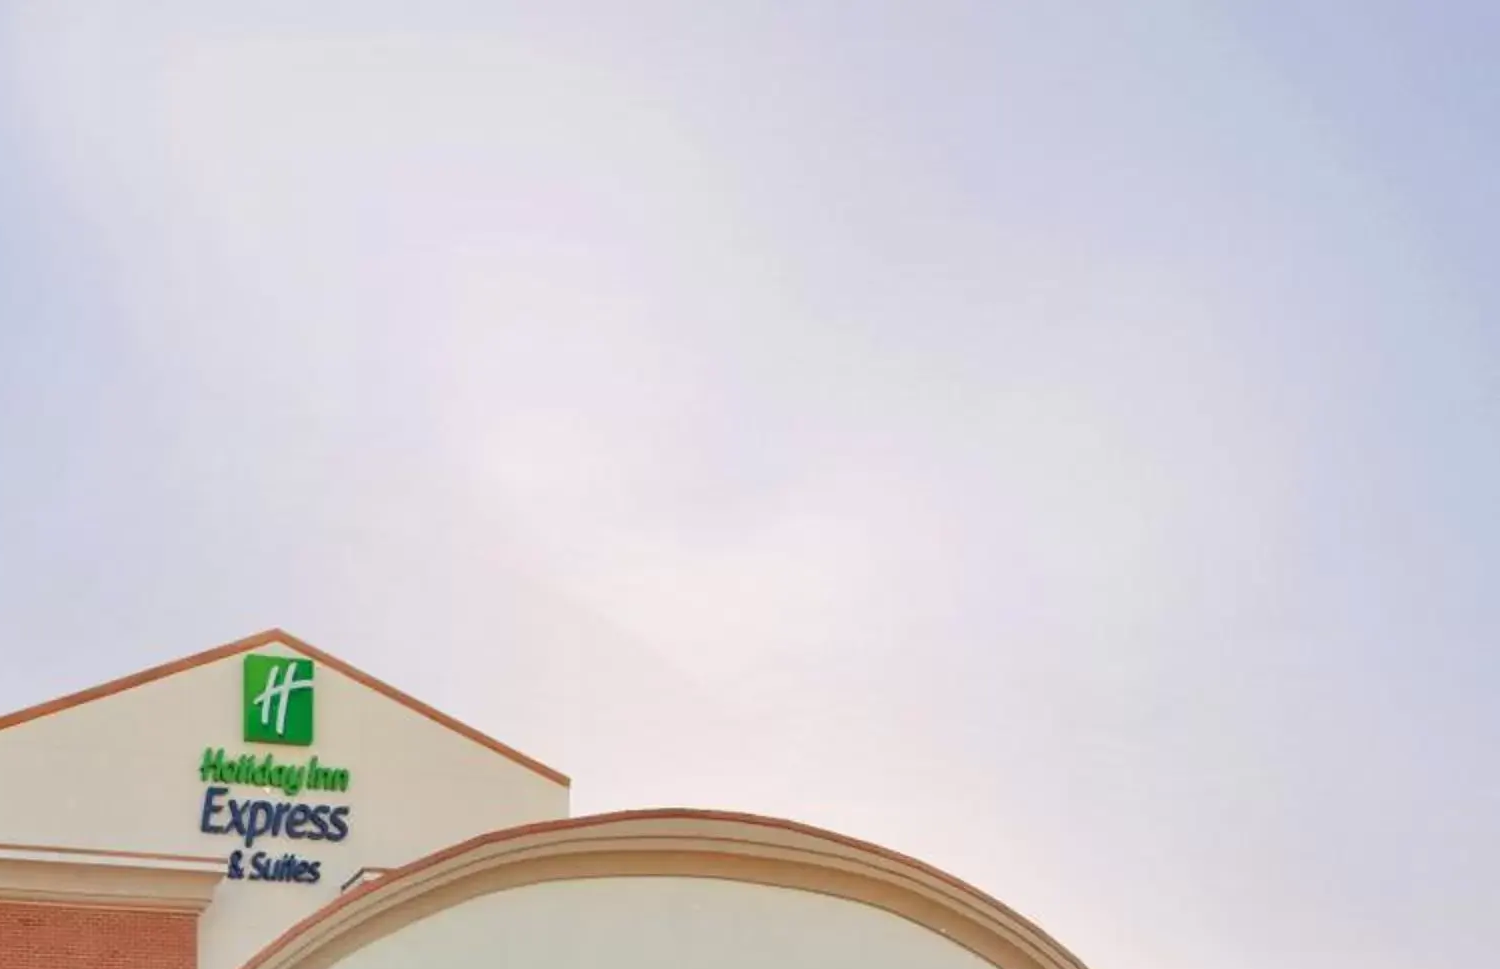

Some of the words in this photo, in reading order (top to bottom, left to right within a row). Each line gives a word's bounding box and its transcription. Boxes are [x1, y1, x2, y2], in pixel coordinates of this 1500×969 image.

[200, 748, 304, 796] Holiday
[307, 756, 349, 792] Inn
[201, 786, 349, 848] Express
[227, 850, 244, 880] &
[248, 852, 321, 883] Suites
